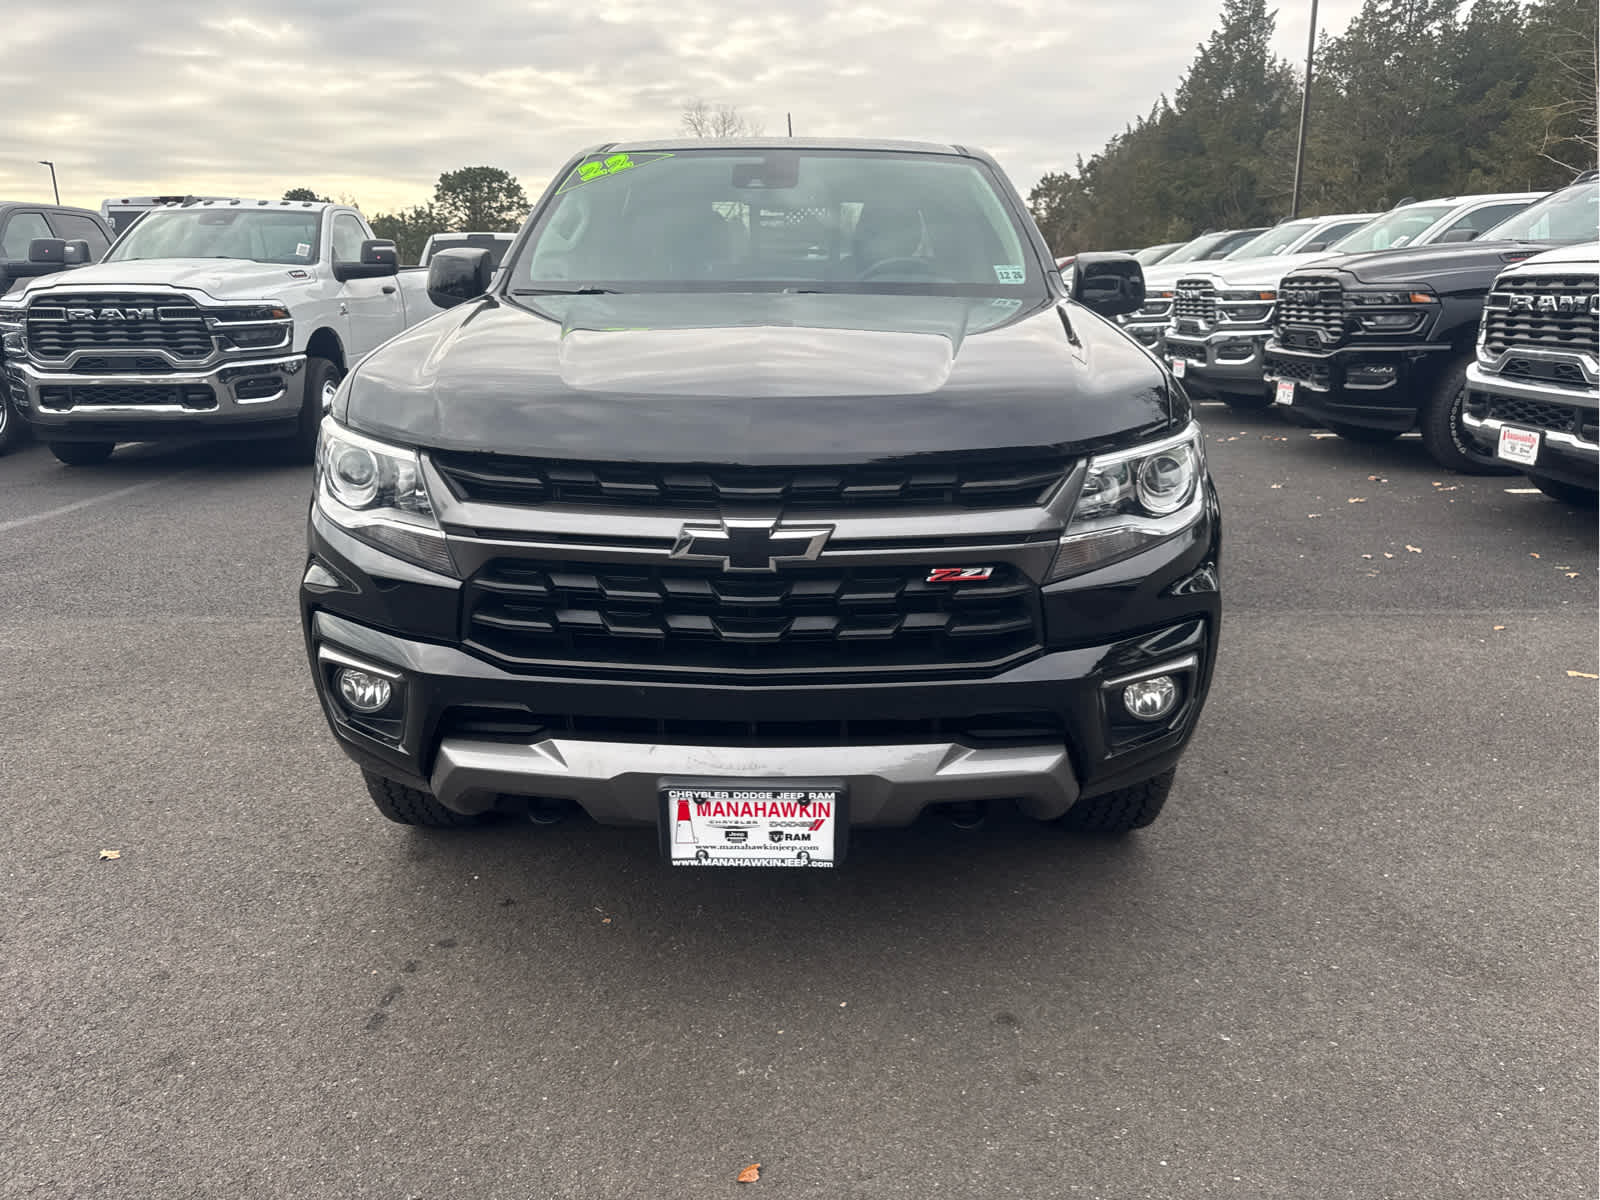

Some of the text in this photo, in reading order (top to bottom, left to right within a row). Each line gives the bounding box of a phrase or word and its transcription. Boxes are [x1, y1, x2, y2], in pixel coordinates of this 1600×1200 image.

[578, 154, 634, 181] 22
[1000, 271, 1011, 280] 12
[1510, 295, 1588, 312] RAM
[66, 308, 154, 321] RAM
[668, 790, 835, 800] CHRYSLER DODGE JEEP RAM
[696, 801, 831, 818] MANAHAWKIN
[785, 833, 811, 841] RAM
[672, 858, 833, 868] www.MANAHAWKINJEEP.com
